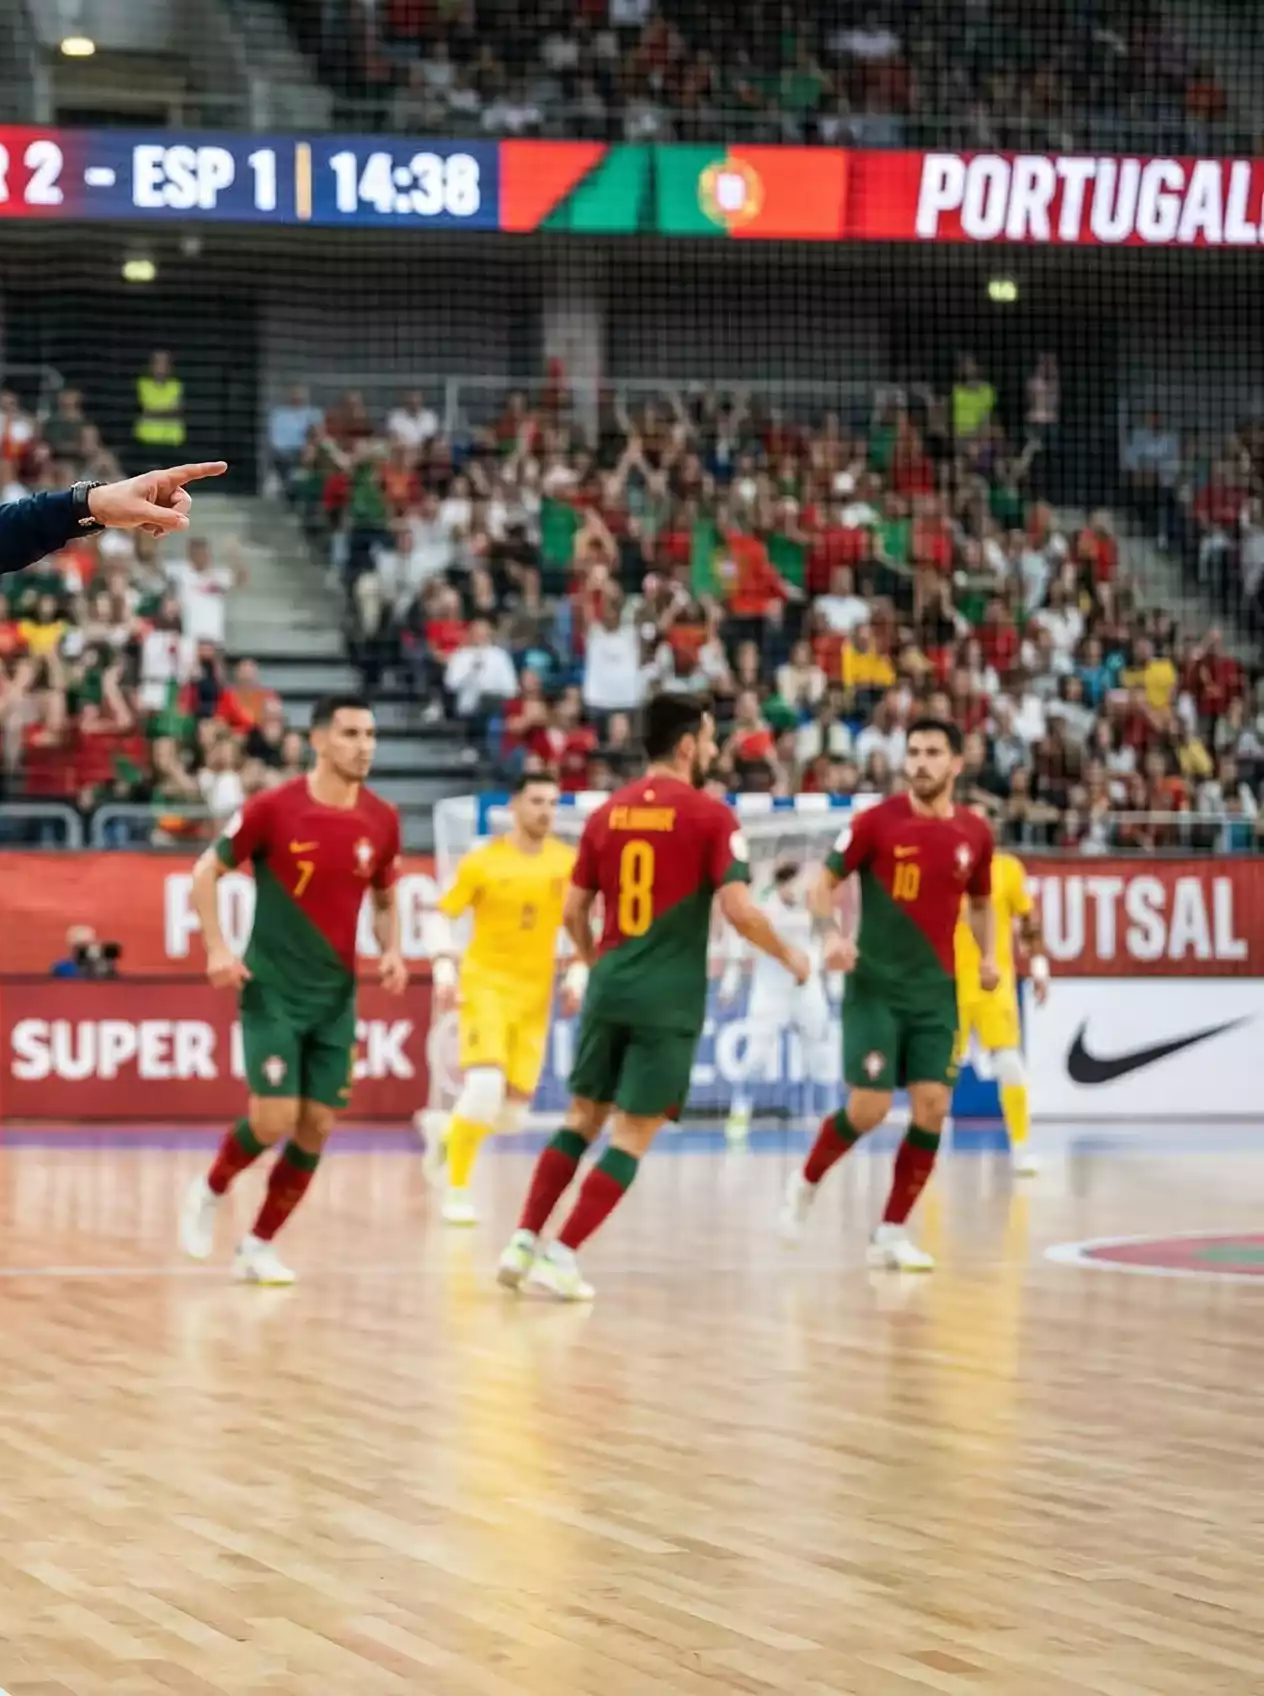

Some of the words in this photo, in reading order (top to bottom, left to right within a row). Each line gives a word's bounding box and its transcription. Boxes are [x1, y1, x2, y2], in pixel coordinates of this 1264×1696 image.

[23, 139, 65, 206] 2
[131, 144, 236, 210] ESP
[247, 148, 277, 212] 1
[329, 151, 481, 217] 14:38
[915, 152, 1264, 244] PORTUGAL
[292, 859, 315, 897] 7
[617, 838, 655, 937] 8
[892, 861, 921, 901] 10
[1020, 873, 1248, 961] UTSAL
[10, 1018, 218, 1081] SUPER
